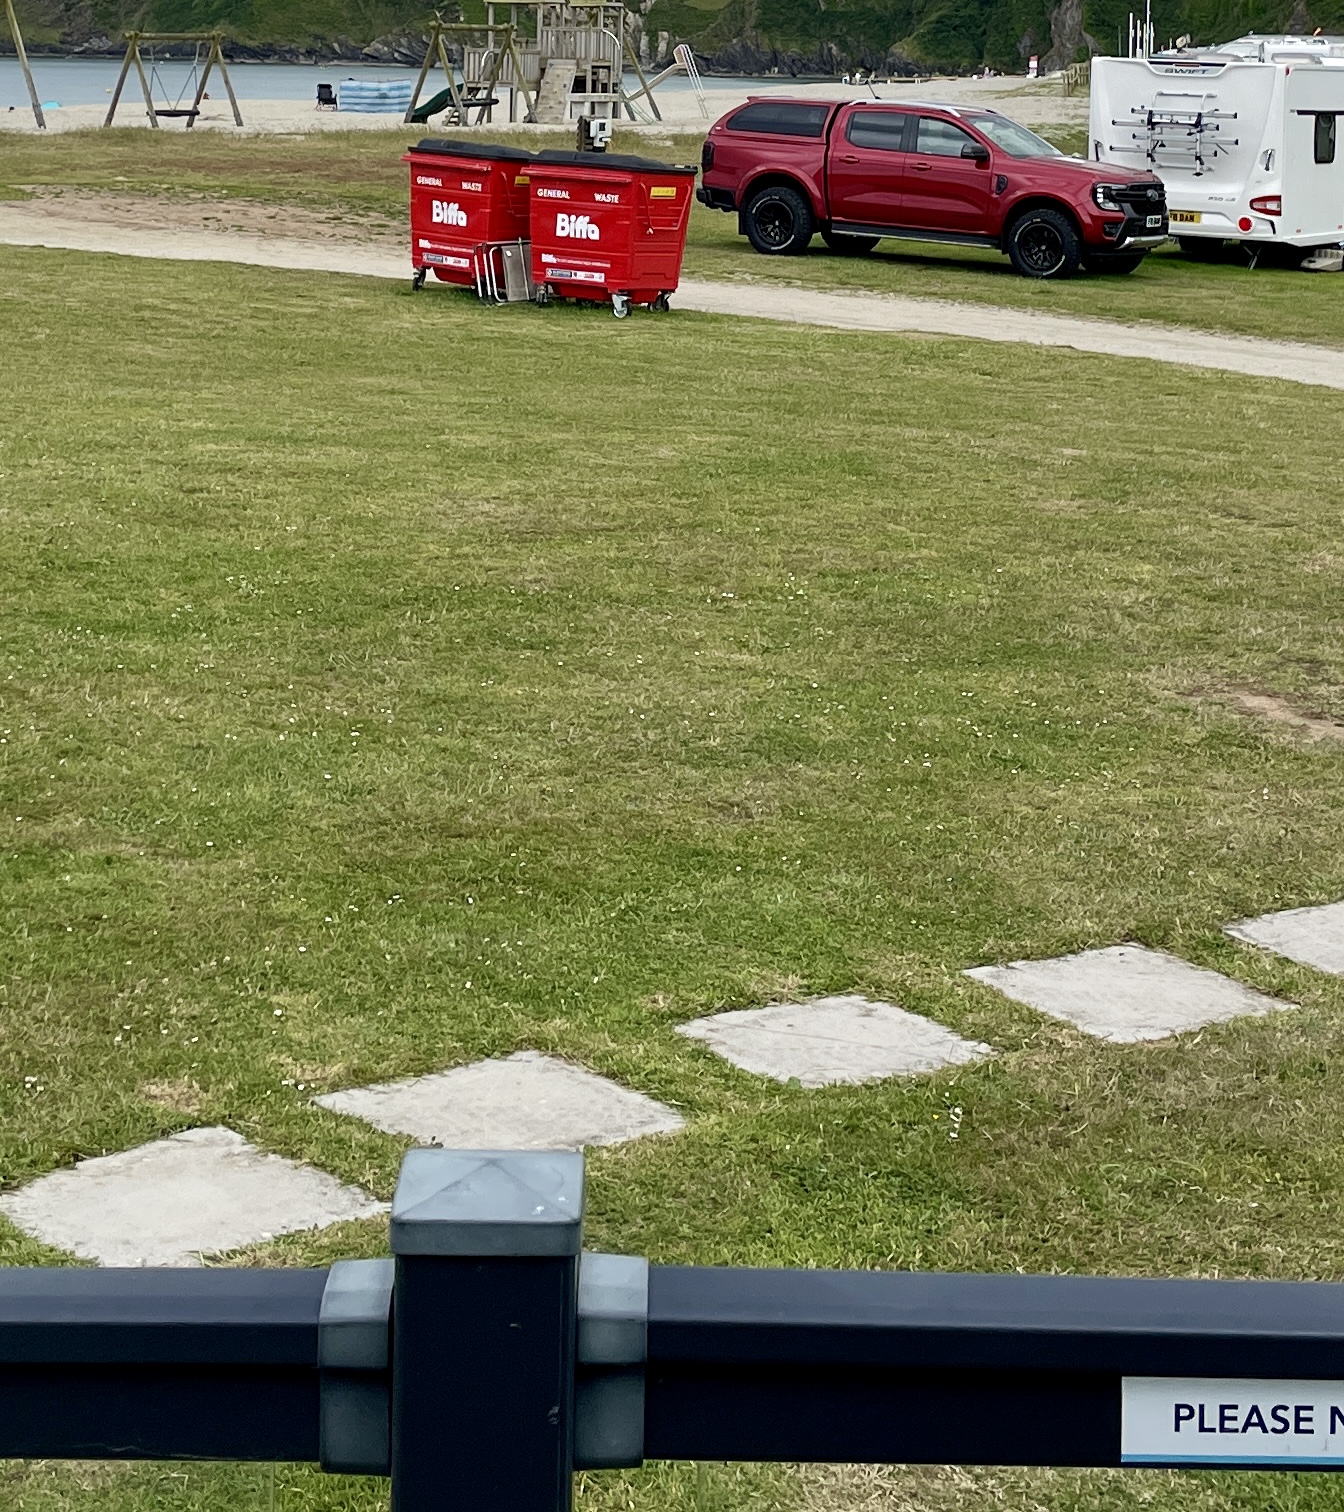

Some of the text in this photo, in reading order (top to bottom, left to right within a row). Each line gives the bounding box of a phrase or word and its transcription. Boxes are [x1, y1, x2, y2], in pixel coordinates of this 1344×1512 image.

[537, 188, 619, 203] GENERAL WASTE
[432, 199, 467, 227] Biffa
[555, 213, 599, 240] Biffa
[1173, 1403, 1315, 1435] PLEASE
